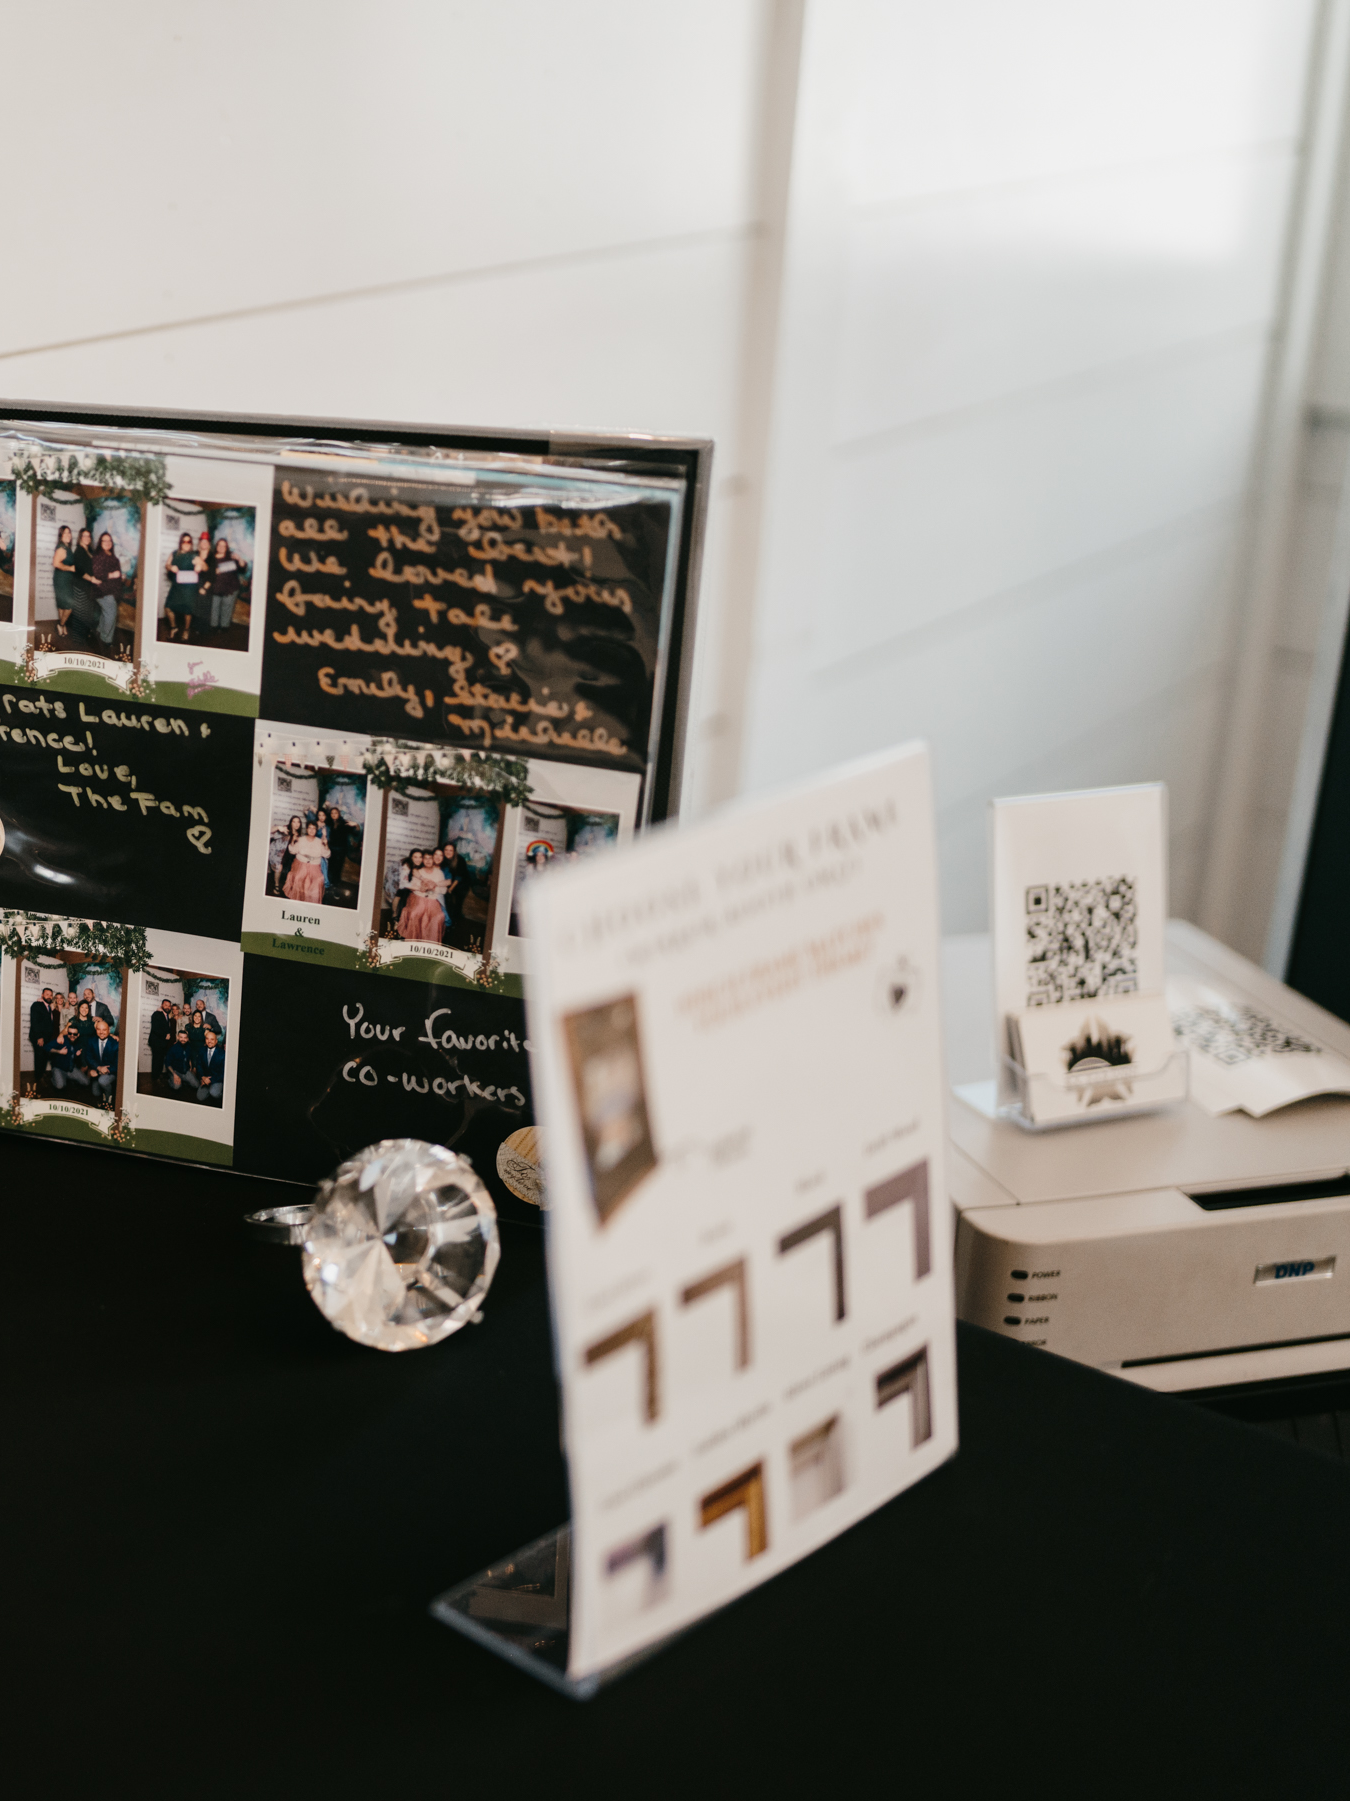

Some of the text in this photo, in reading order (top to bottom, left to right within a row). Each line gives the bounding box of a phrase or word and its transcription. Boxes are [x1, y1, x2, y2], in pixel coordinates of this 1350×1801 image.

[278, 517, 593, 578] all the best!
[278, 547, 632, 616] We loved your
[275, 579, 519, 634] fairy tale
[64, 656, 106, 669] 10/10/2021
[273, 624, 474, 679] wedding
[317, 666, 435, 718] Emily,
[79, 702, 189, 736] Lauren
[448, 713, 628, 756] Michelle
[57, 754, 136, 789] Love,
[58, 783, 209, 823] The Fam
[281, 910, 321, 925] Lauren
[295, 927, 305, 938] &
[272, 938, 325, 955] Lawrence
[409, 945, 454, 959] 10/10/2021
[342, 1003, 406, 1041] Your
[49, 1104, 89, 1117] 10/10/2021
[1032, 1269, 1061, 1279] POWER
[1274, 1261, 1315, 1279] DNP
[1024, 1316, 1049, 1325] PAPER
